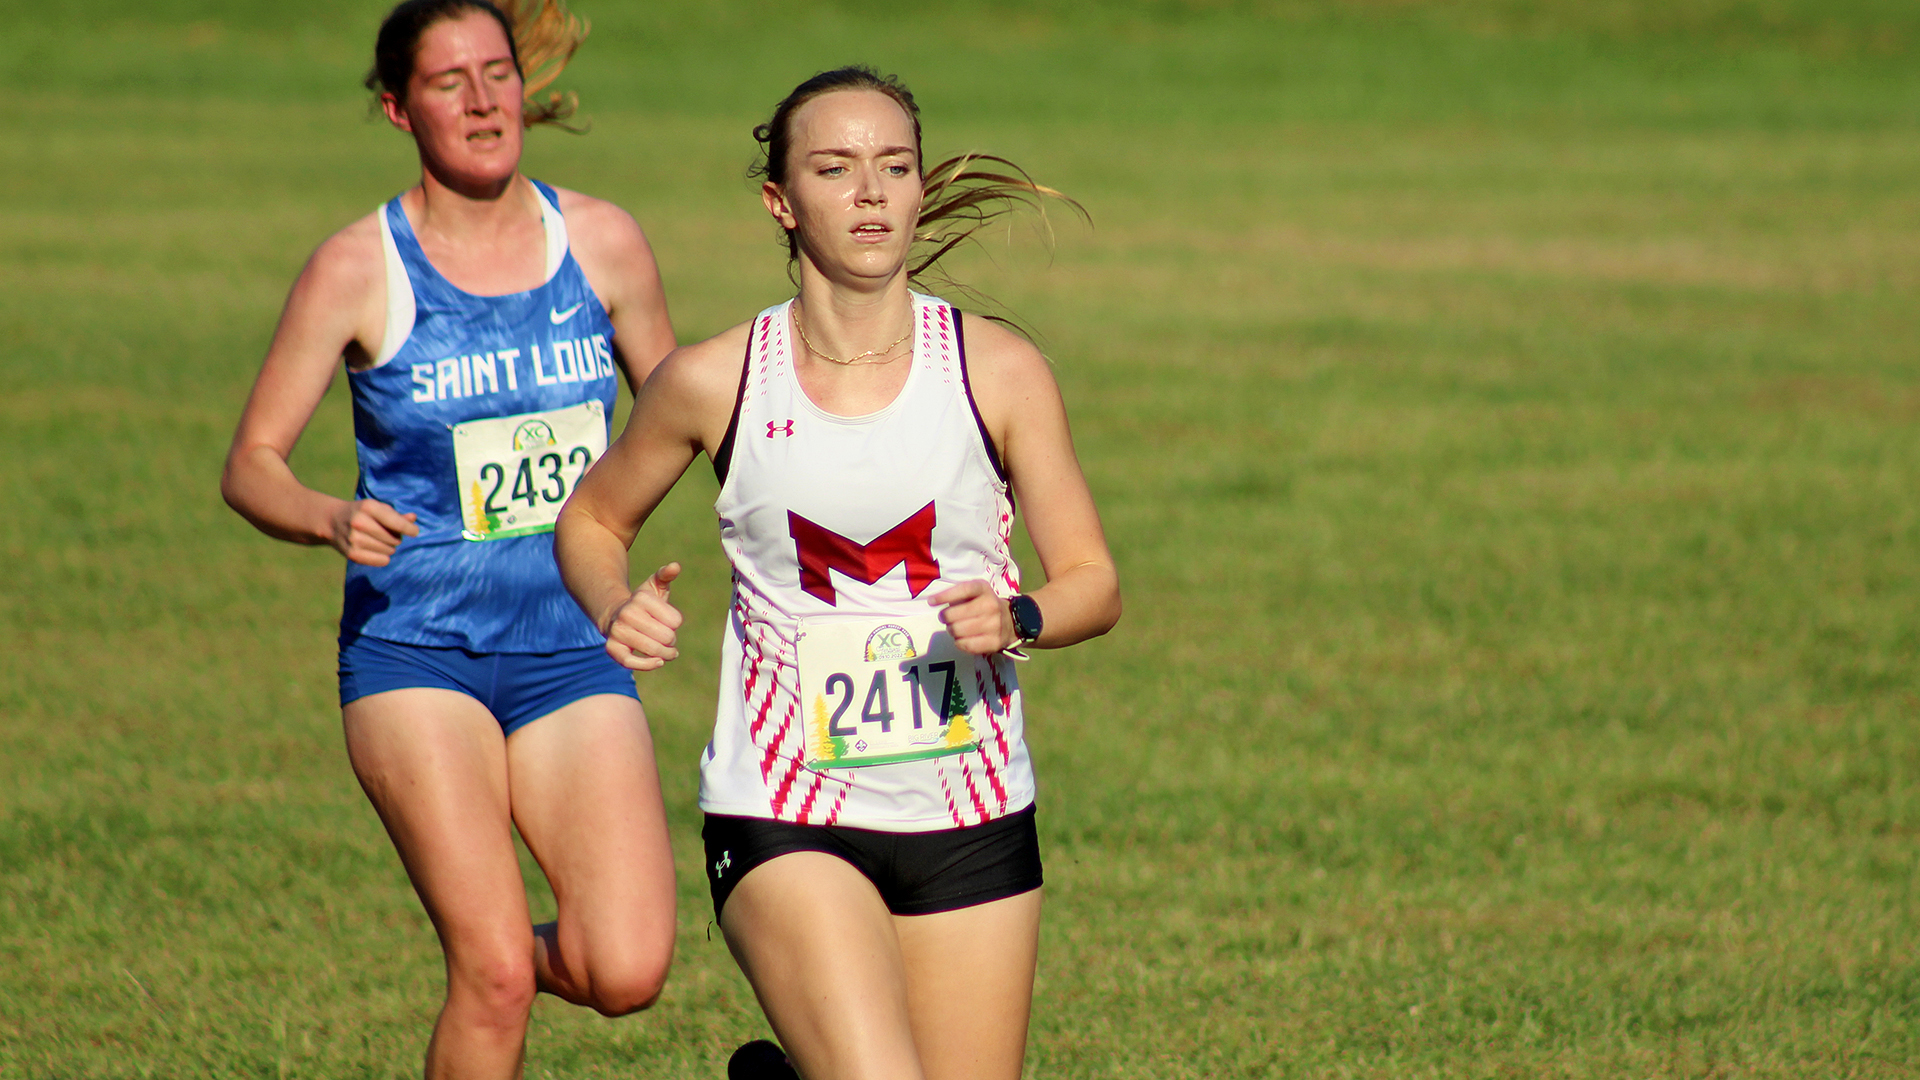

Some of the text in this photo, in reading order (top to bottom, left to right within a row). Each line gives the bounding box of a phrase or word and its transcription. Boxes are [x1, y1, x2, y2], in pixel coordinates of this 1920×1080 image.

[411, 333, 615, 403] SAINT LOUIS
[522, 425, 545, 440] XC
[787, 499, 941, 607] M
[877, 632, 902, 648] XC
[825, 660, 956, 737] 2417
